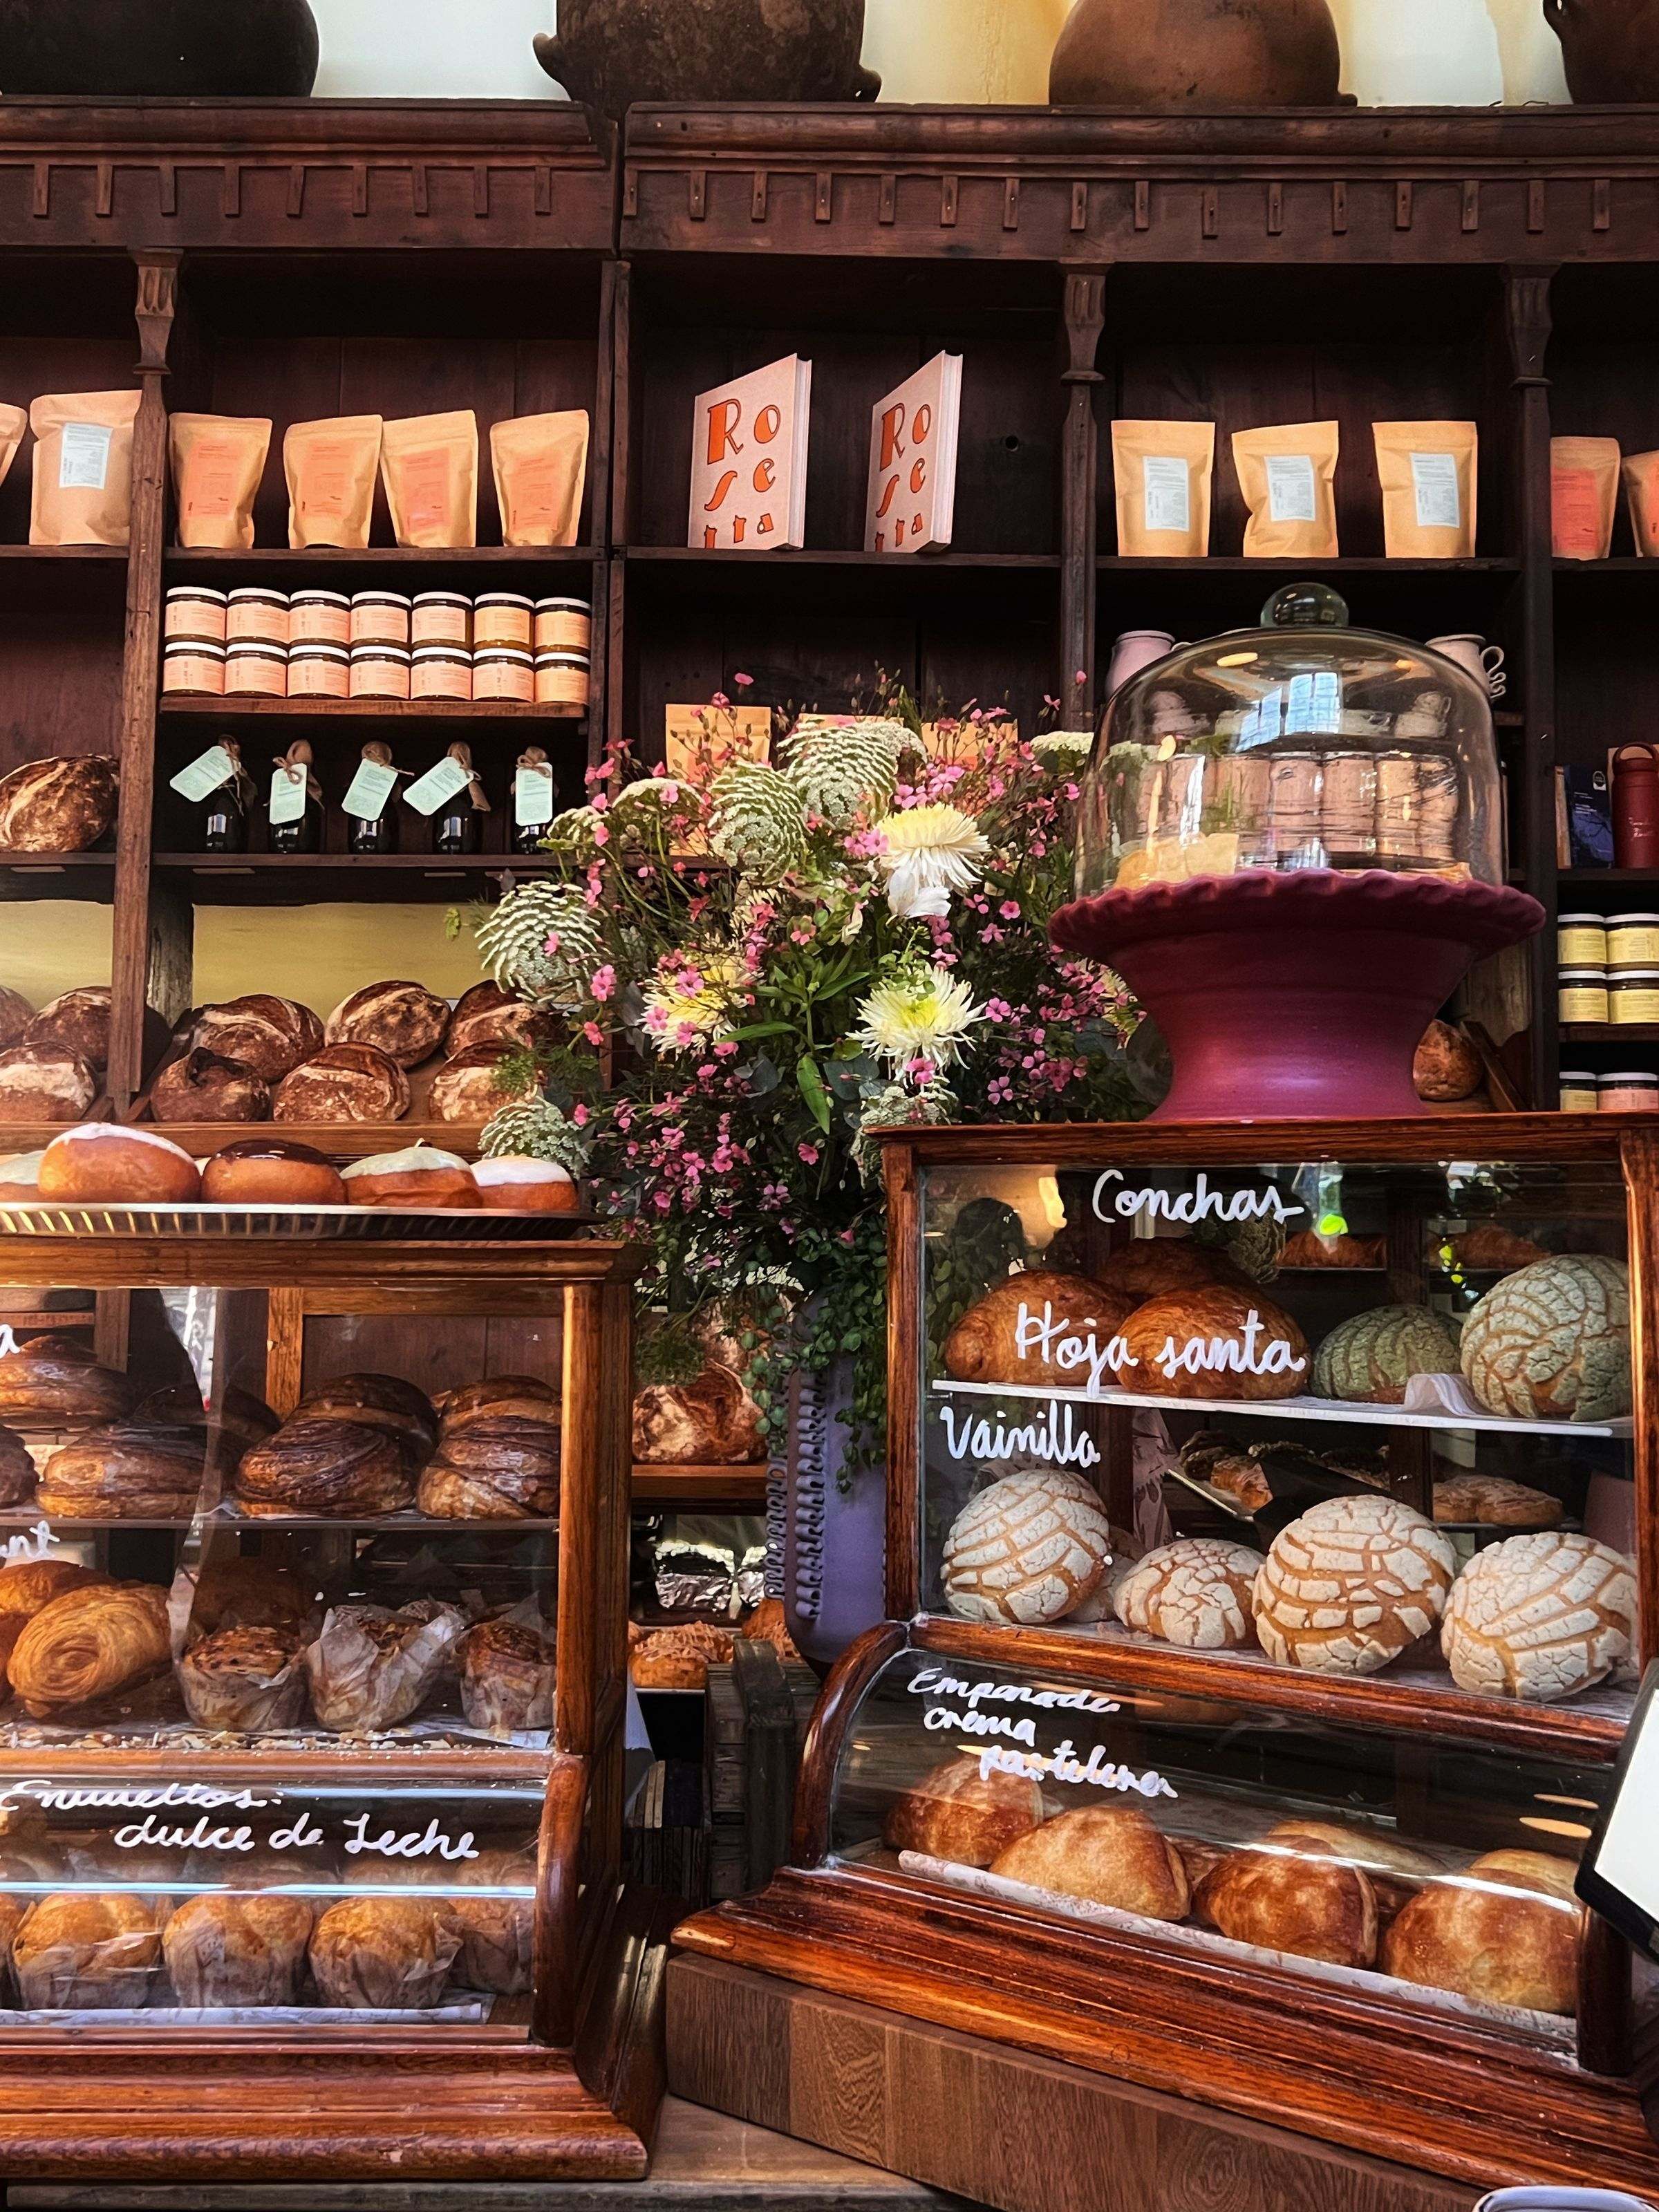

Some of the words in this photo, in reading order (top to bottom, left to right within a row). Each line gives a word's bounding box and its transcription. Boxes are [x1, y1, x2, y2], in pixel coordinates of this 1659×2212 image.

[707, 398, 781, 465] Ro
[879, 402, 931, 471] Ro
[1093, 1169, 1304, 1224] Conchas
[1015, 1300, 1138, 1398] Hoja
[1155, 1309, 1306, 1378] santa
[939, 1400, 1100, 1468] Vainilla
[114, 1815, 255, 1850] dulce
[268, 1812, 324, 1850] de
